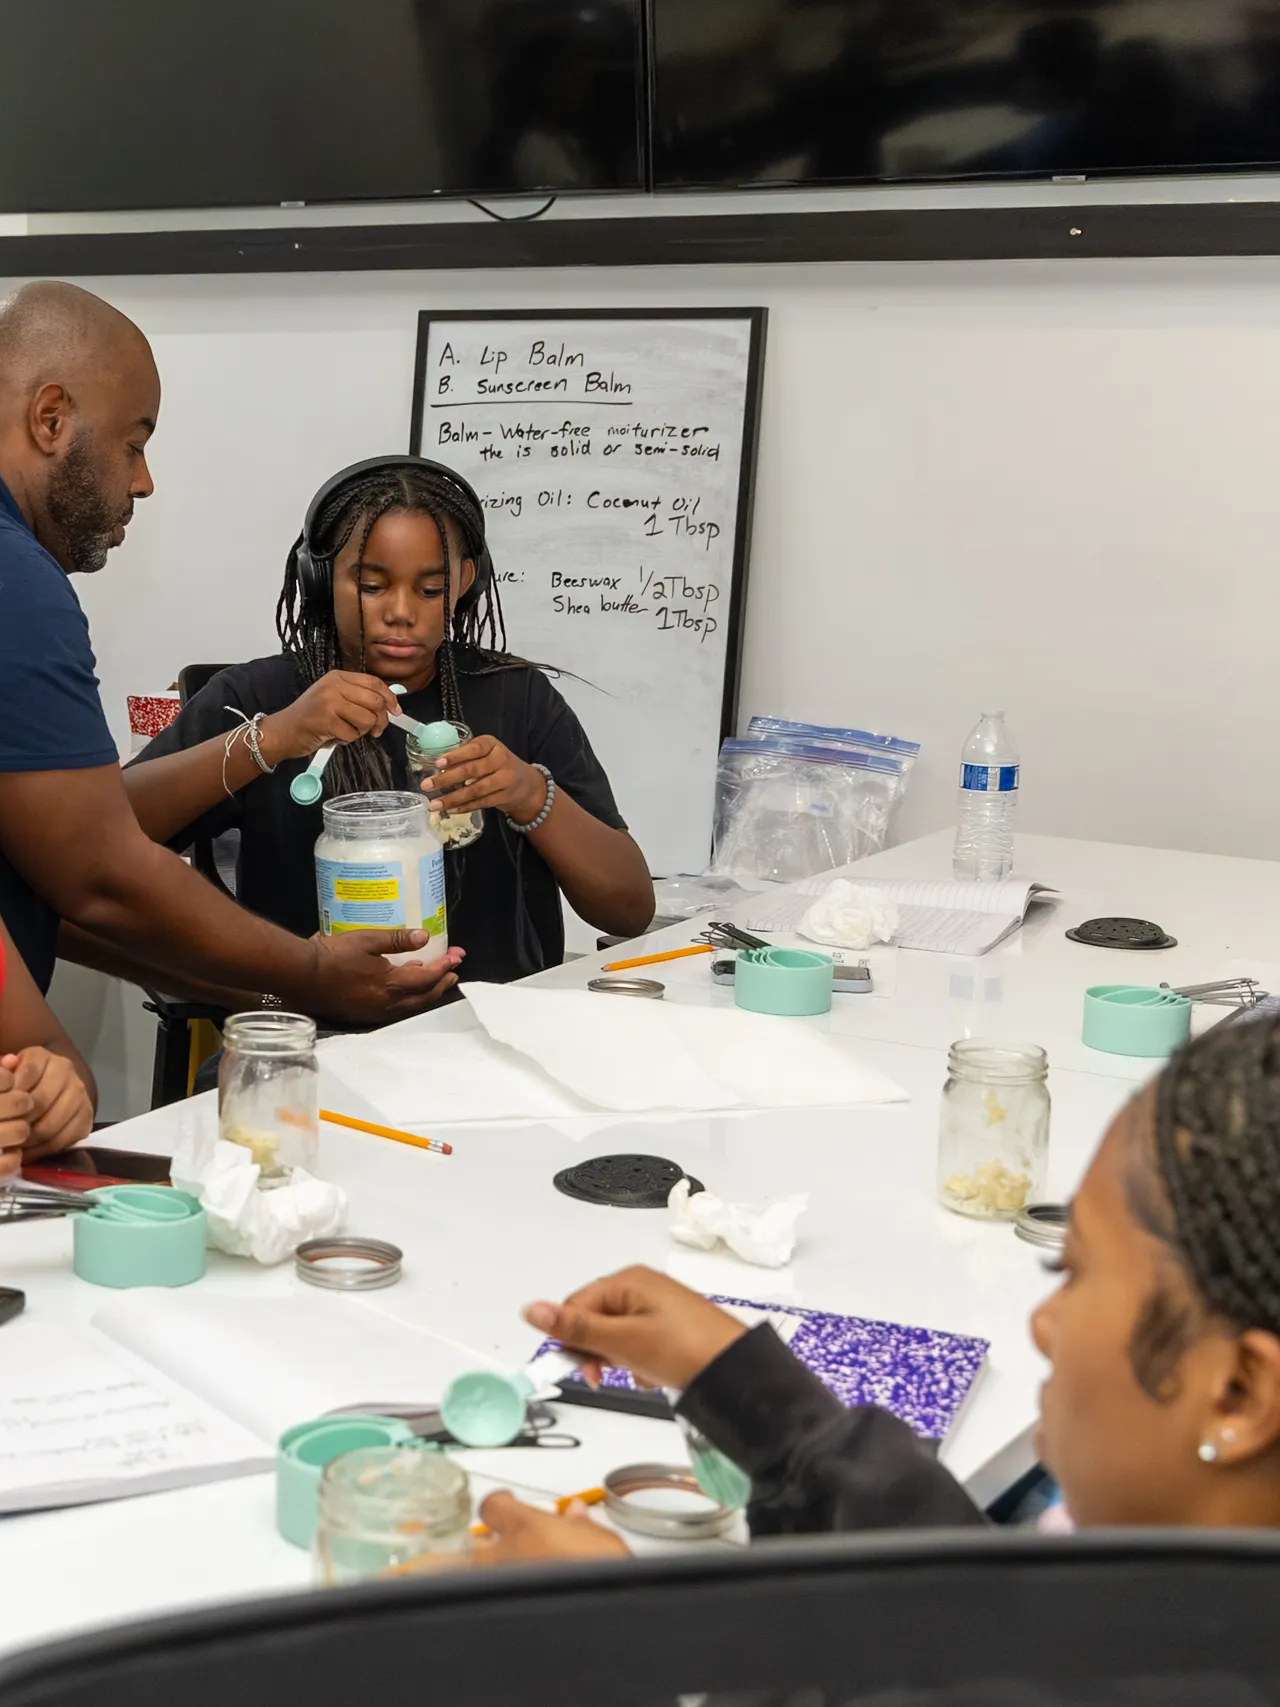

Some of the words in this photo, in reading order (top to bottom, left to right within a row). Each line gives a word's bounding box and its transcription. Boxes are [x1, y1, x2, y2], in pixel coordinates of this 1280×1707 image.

[439, 342, 460, 367] A.
[480, 345, 508, 374] Lip
[529, 341, 584, 367] Balm
[438, 375, 454, 395] B.
[477, 378, 567, 395] Sunscreen
[585, 371, 632, 394] Balm
[607, 422, 709, 439] moiturizer
[480, 443, 503, 462] the
[517, 444, 531, 458] is
[550, 439, 591, 458] solid
[603, 443, 622, 456] or
[634, 441, 720, 462] semi-solid
[480, 491, 522, 517] rizing
[537, 489, 572, 507] Oil:
[668, 515, 721, 551] Tbsp
[494, 571, 524, 583] ure:
[551, 571, 622, 590] Beeswax
[553, 594, 591, 615] Shea
[600, 594, 649, 614] butter
